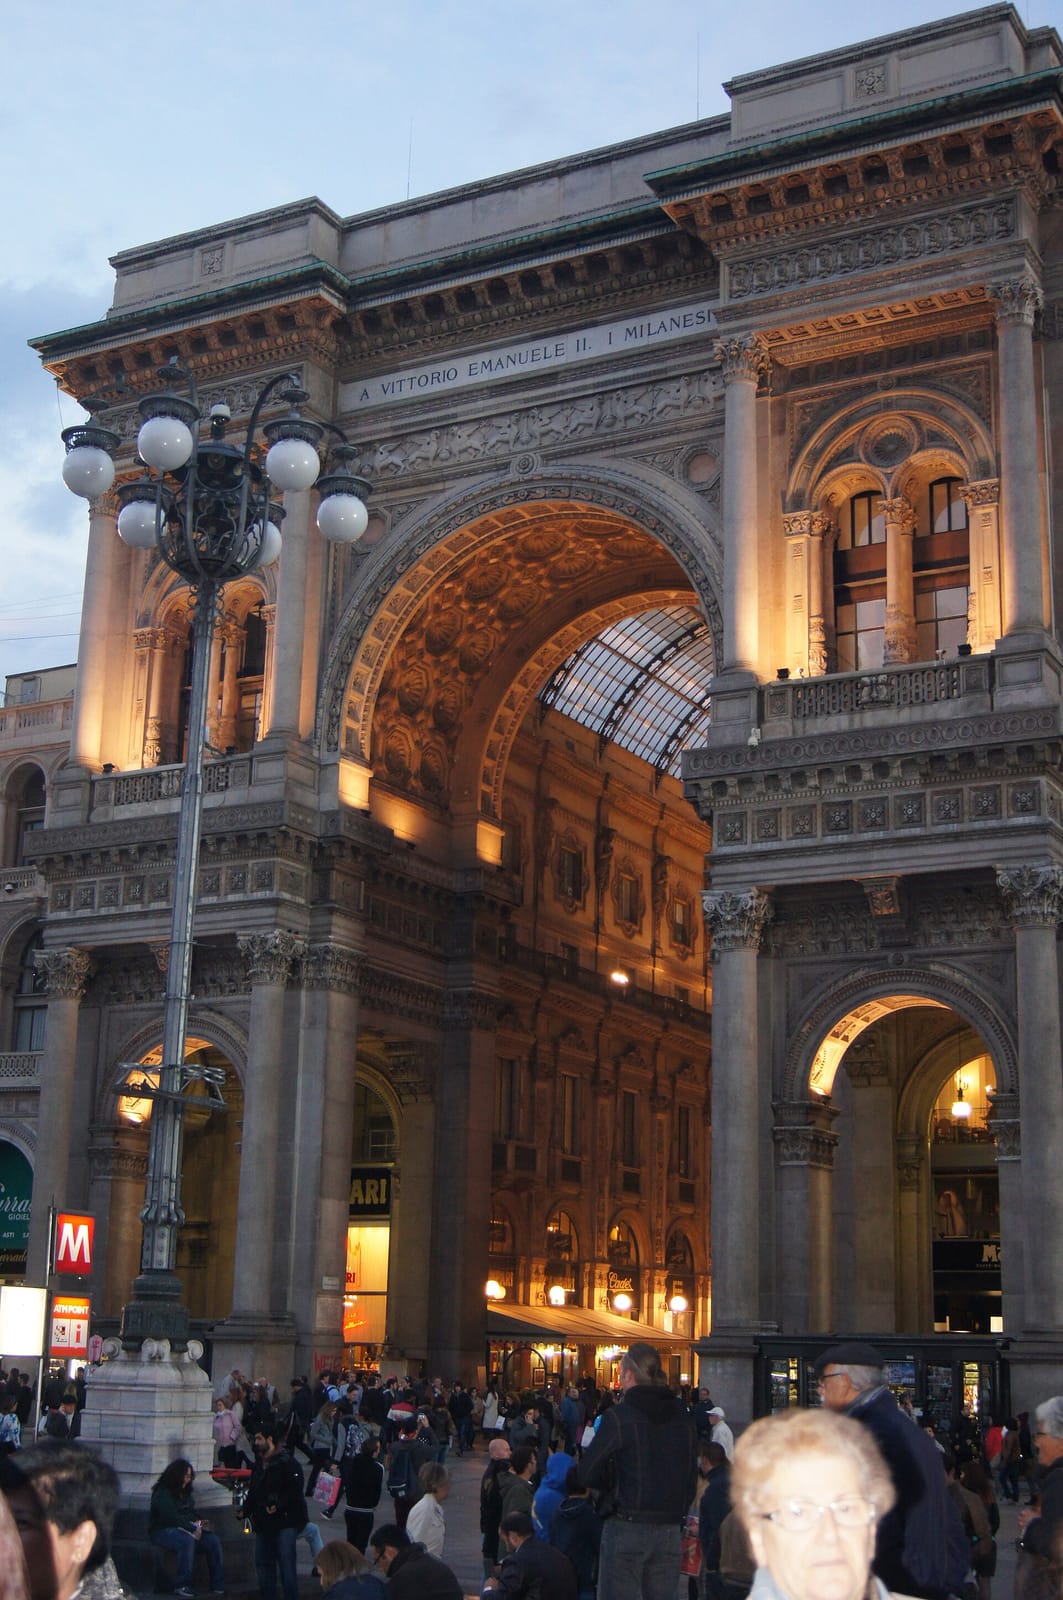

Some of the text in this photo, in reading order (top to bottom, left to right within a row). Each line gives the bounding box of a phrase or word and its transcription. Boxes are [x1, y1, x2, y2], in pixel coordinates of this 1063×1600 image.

[360, 387, 370, 401] A
[381, 367, 458, 395] VITTORIO
[468, 343, 565, 376] EMANUELE
[624, 309, 711, 341] MILANESI
[57, 1222, 91, 1263] M
